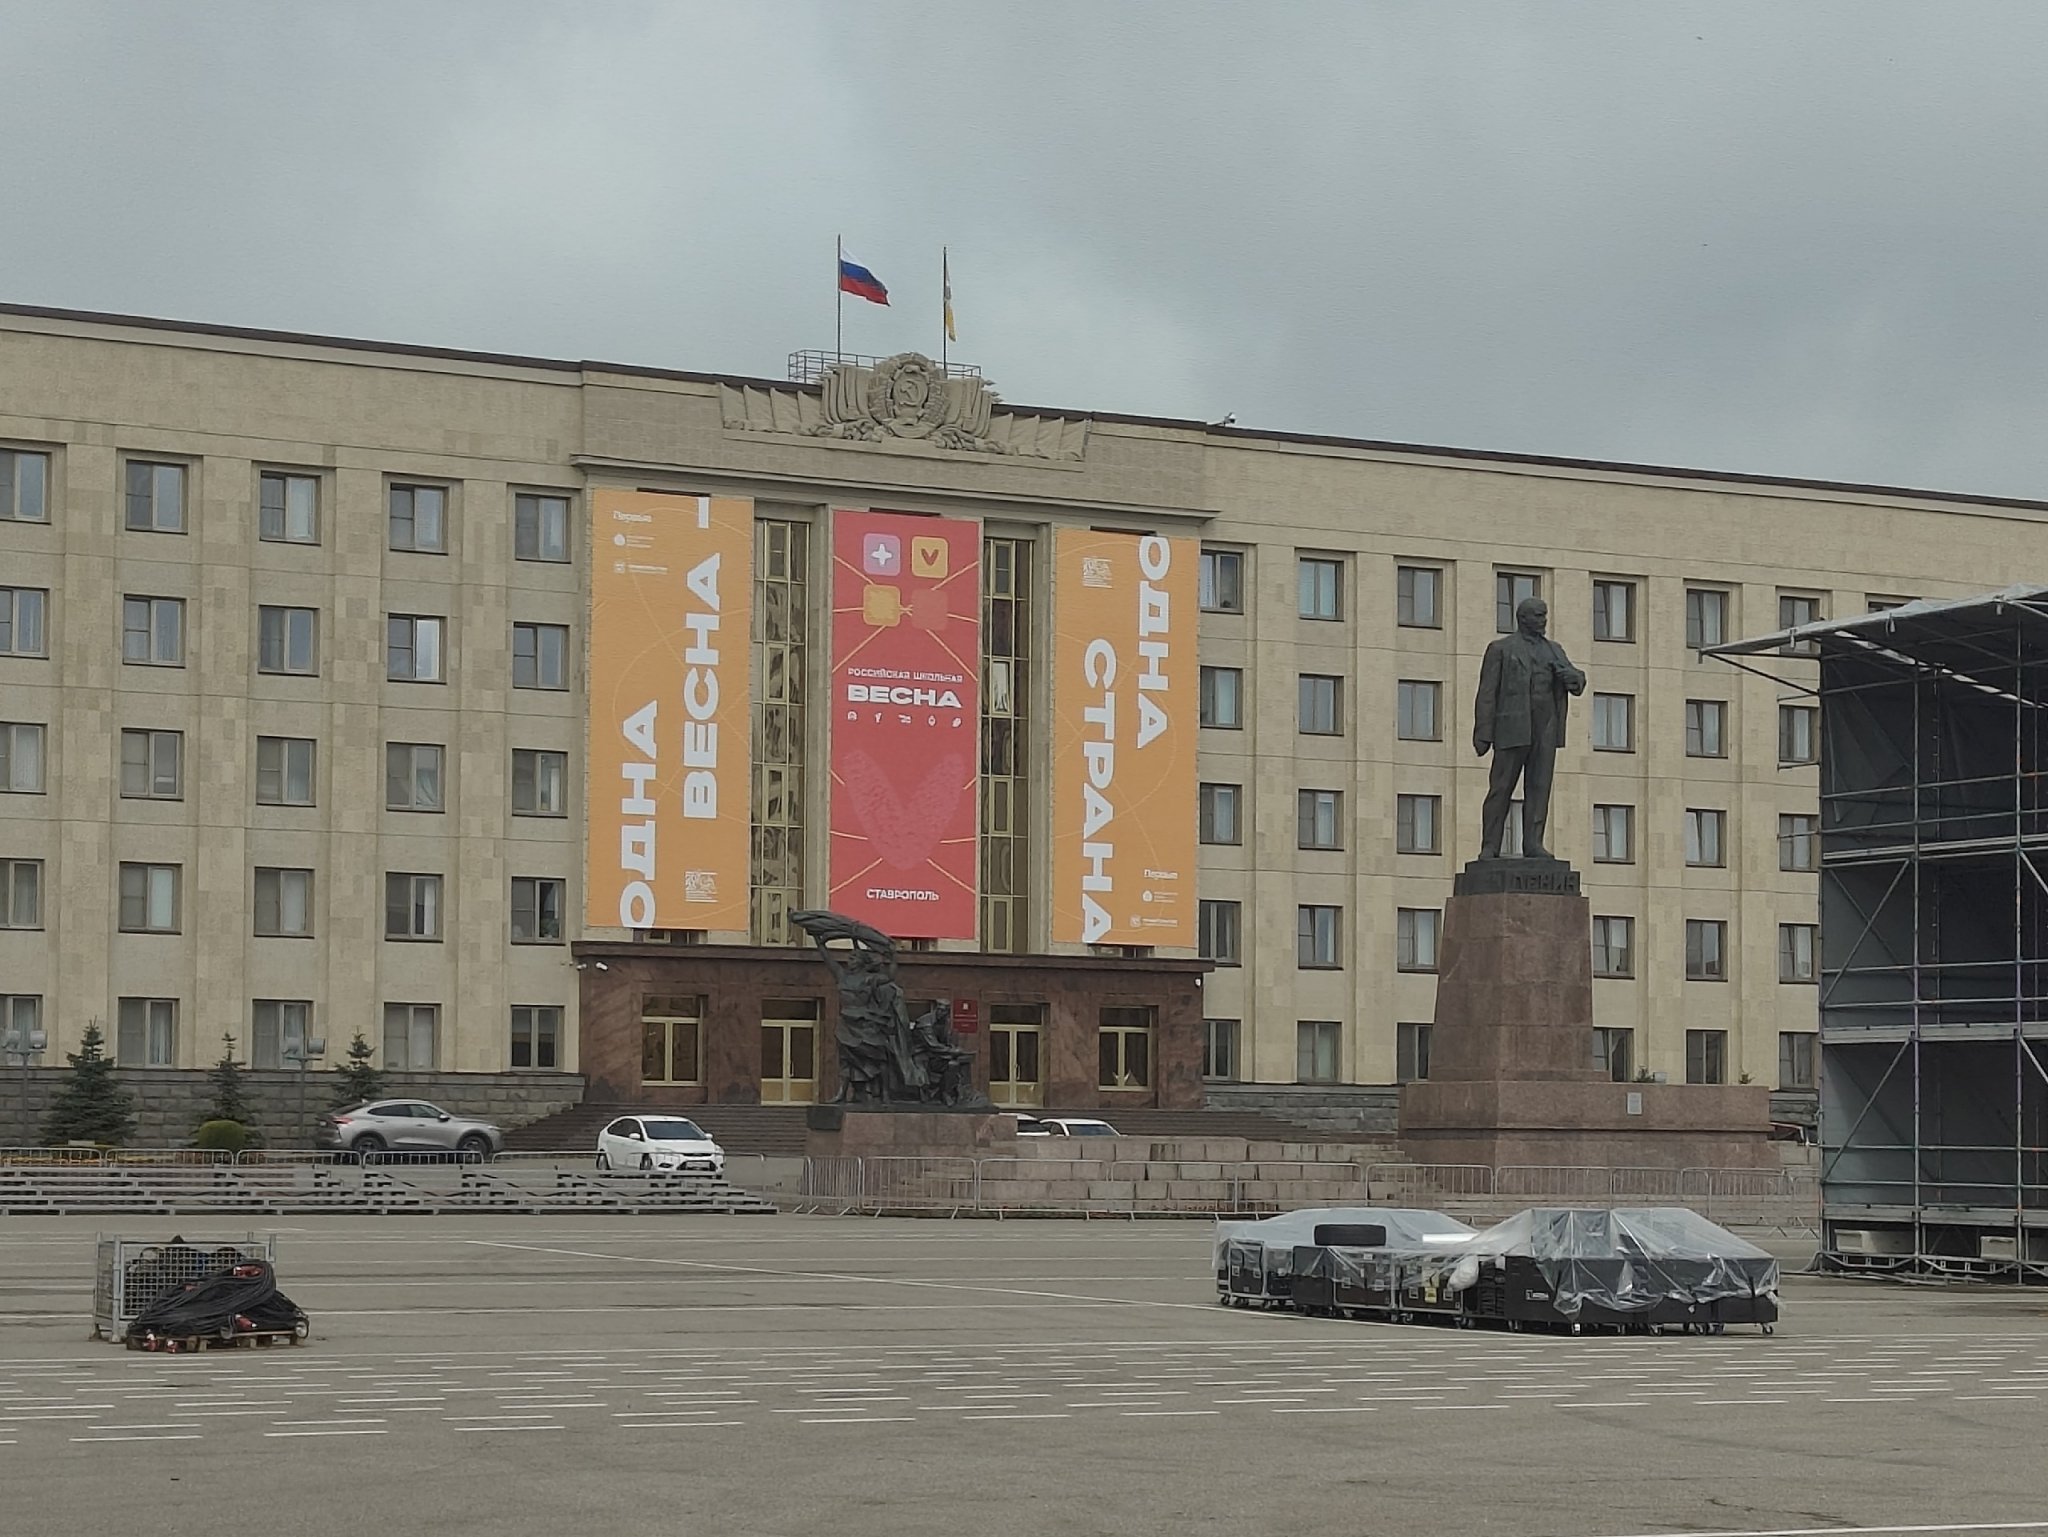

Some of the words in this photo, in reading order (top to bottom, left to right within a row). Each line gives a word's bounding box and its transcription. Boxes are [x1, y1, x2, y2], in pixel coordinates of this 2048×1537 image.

[682, 552, 720, 819] ВЕСНА
[847, 667, 910, 680] РОССИЙСКАЯ
[913, 670, 963, 683] ШКОЛЬНАЯ
[847, 683, 962, 708] ВЕСНА
[1137, 536, 1171, 749] ОДНА
[619, 700, 657, 929] ОДНА
[1081, 638, 1117, 943] СТРАНА
[866, 888, 940, 901] СТАВРОПОЛЬ
[1509, 873, 1575, 892] ЛЕНИН
